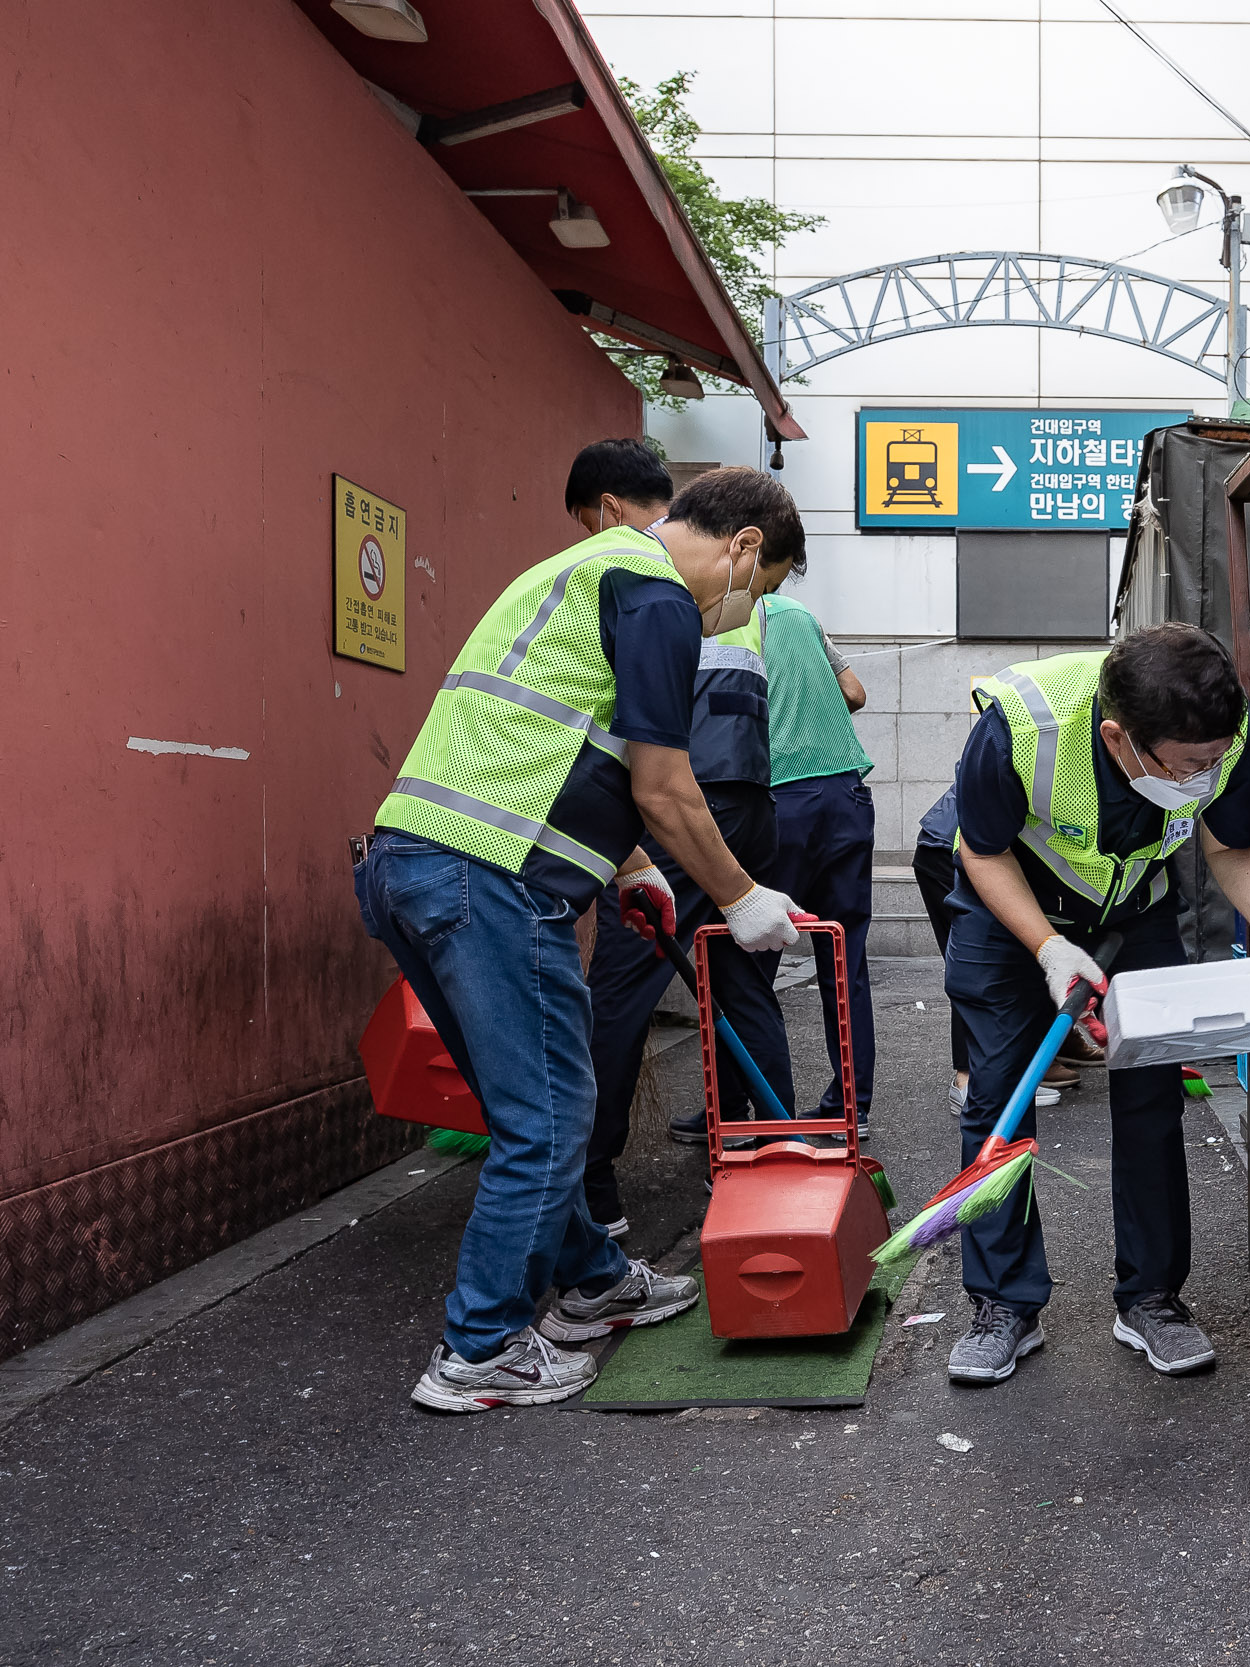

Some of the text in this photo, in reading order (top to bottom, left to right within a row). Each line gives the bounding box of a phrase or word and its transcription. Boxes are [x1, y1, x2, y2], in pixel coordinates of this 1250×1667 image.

[1031, 419, 1101, 435] 건대입구역
[1031, 474, 1101, 489] 건대입구역
[344, 491, 399, 540] 흡연금지
[1030, 493, 1105, 520] 만남의
[346, 597, 397, 626] 간접흡연 피해로
[346, 617, 397, 646] 고통 받고 있습니다
